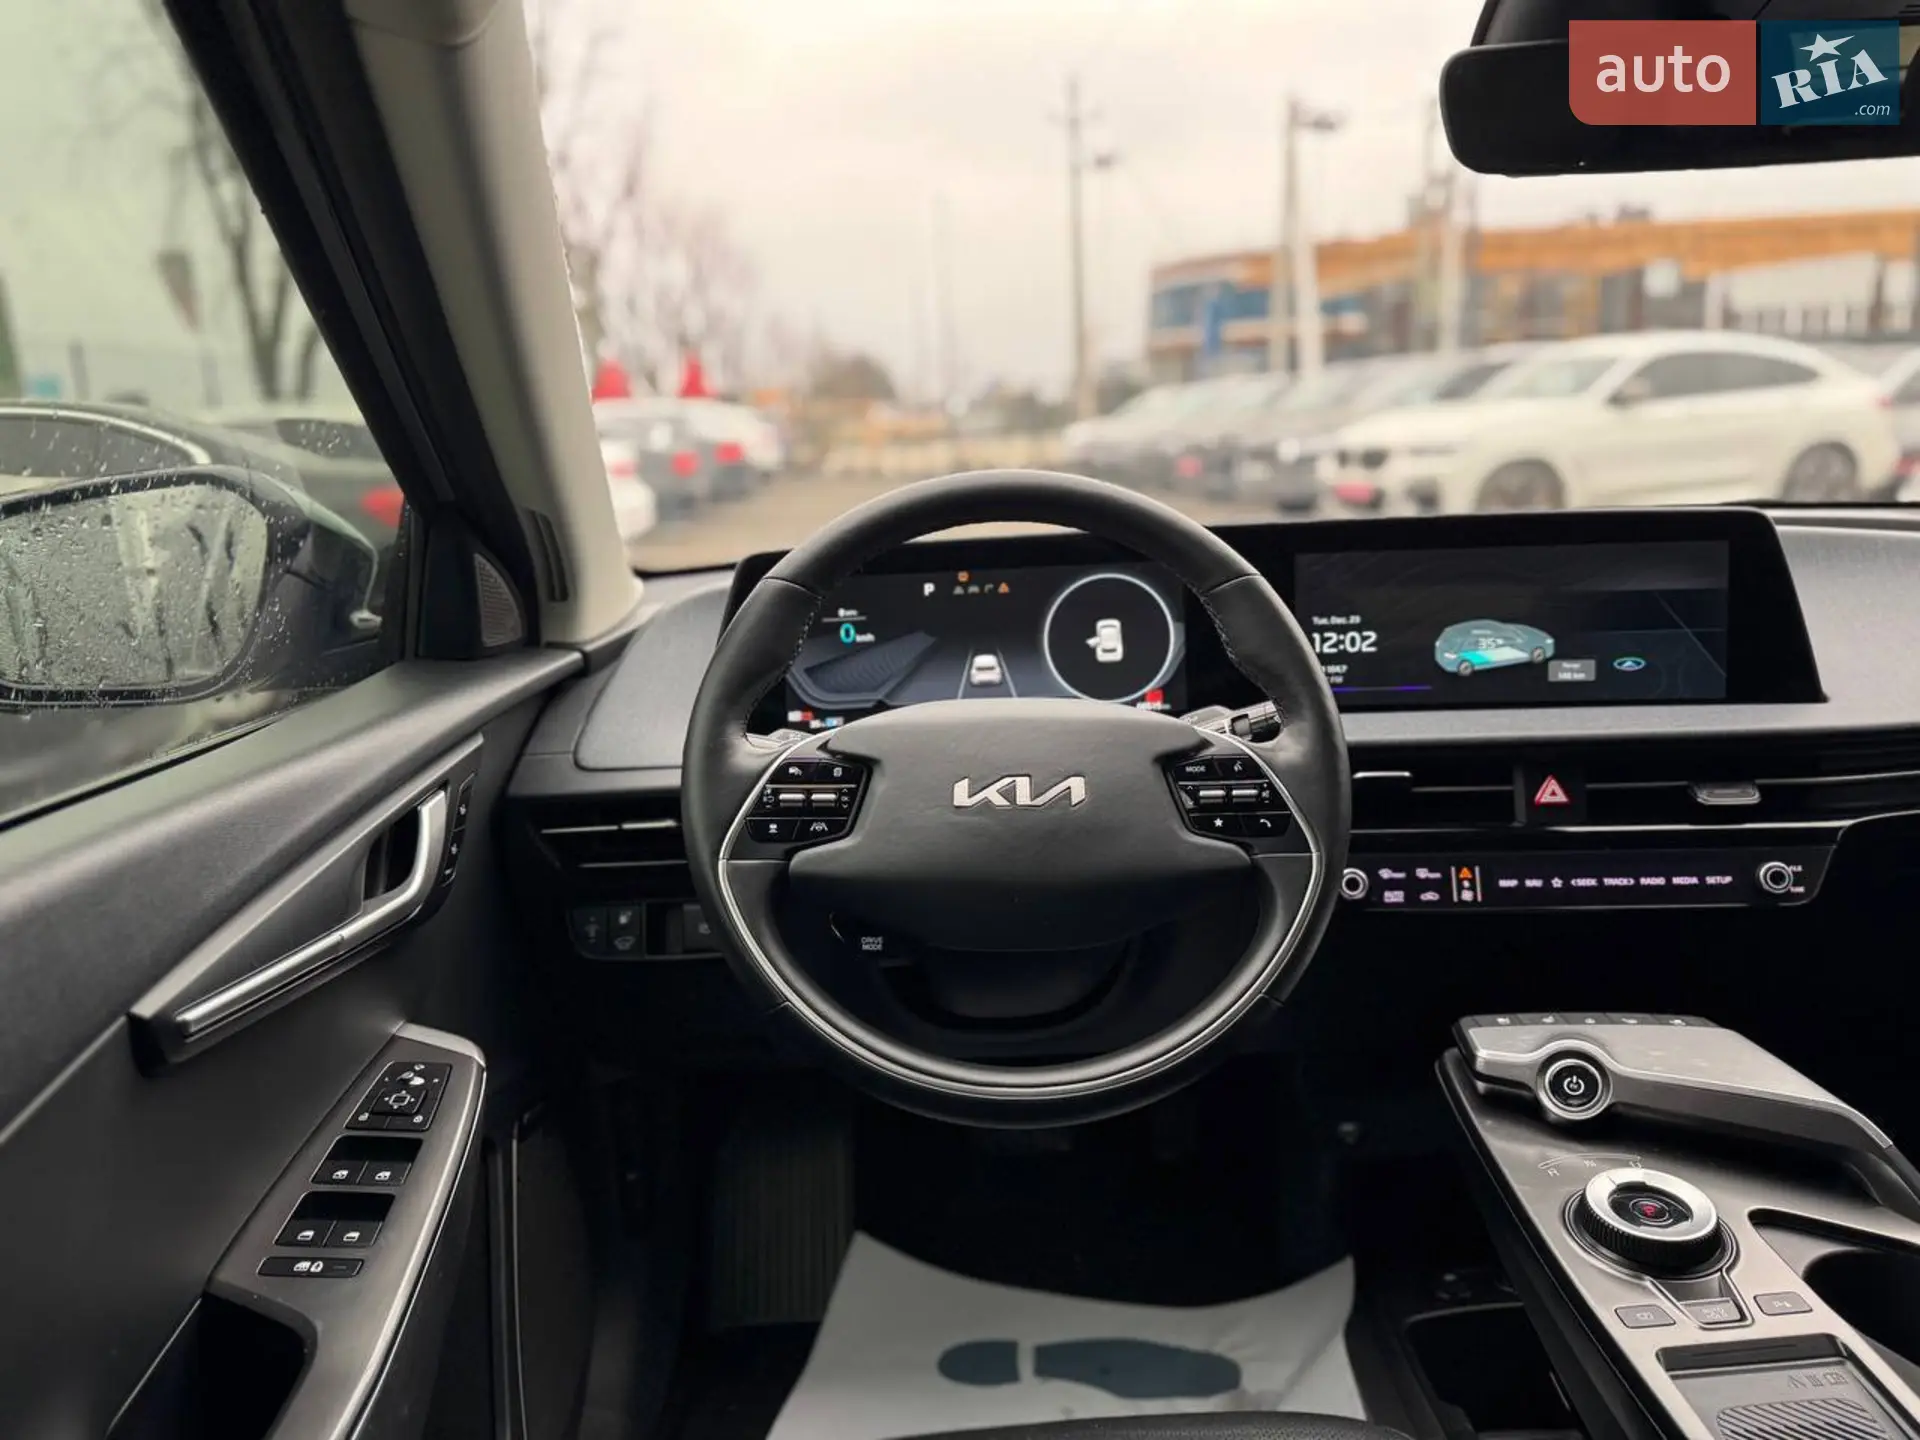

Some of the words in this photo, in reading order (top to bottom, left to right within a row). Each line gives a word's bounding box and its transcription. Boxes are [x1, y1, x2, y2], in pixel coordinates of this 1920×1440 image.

[923, 582, 936, 597] P
[840, 623, 856, 644] 0
[1312, 631, 1378, 653] 12:02
[1184, 764, 1207, 773] MODE
[953, 775, 1086, 808] KIA
[1639, 875, 1667, 886] RADIO
[1671, 875, 1700, 885] MEDIA
[1705, 875, 1733, 885] SETUP
